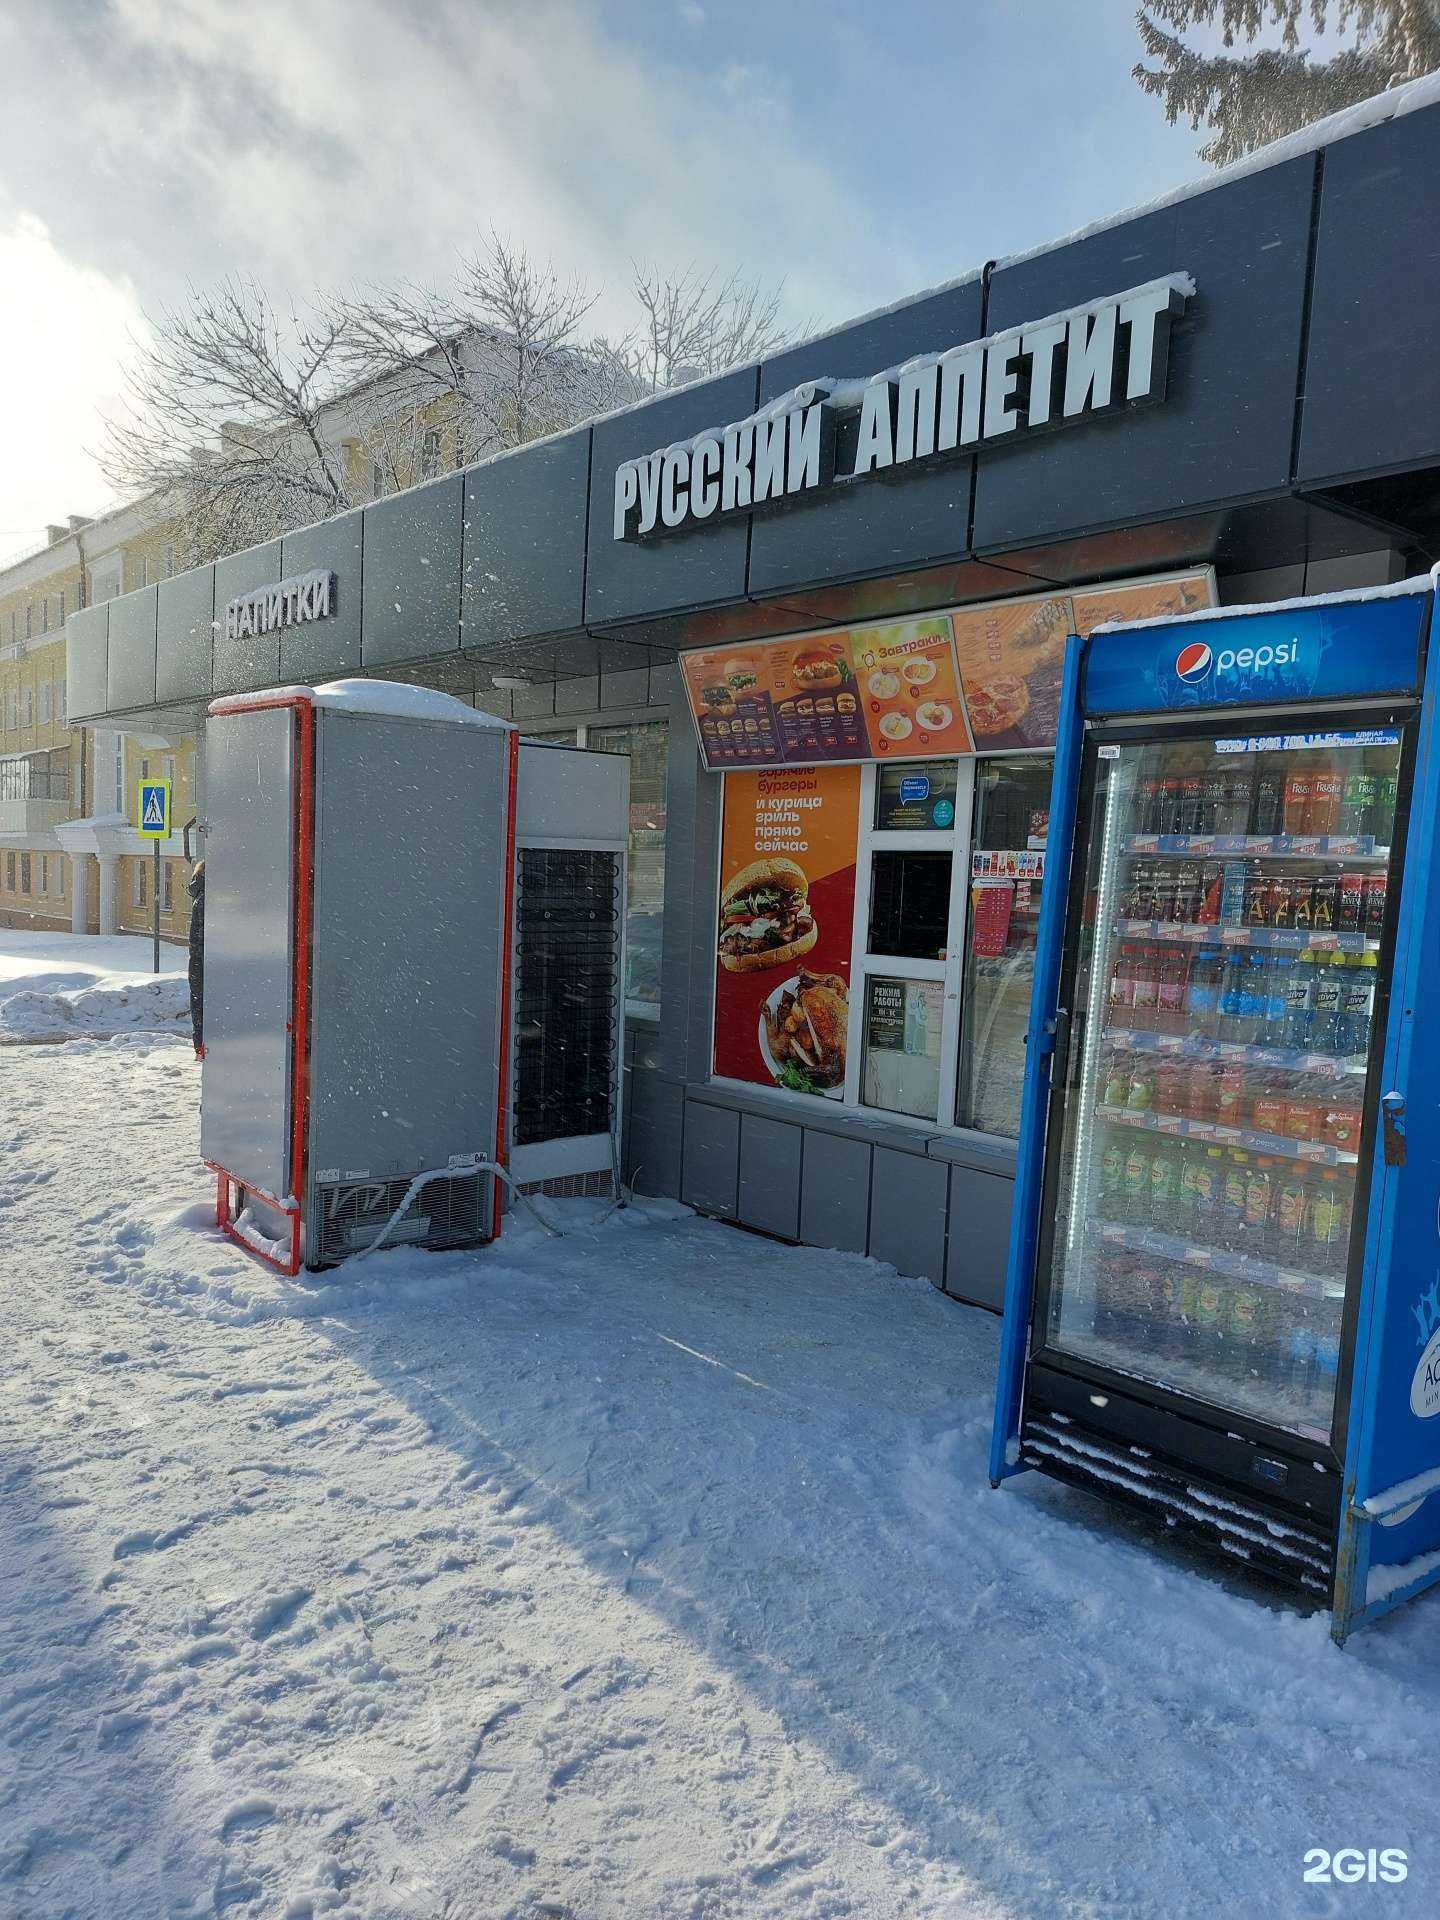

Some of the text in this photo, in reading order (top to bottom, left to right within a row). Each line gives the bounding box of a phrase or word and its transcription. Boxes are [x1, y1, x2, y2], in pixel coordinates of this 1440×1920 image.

[614, 287, 1170, 540] РУССКИЙ АППЕТИТ
[225, 574, 331, 641] НАПИТКИ
[879, 634, 941, 658] Завтраки
[1217, 637, 1298, 676] pepsi
[758, 778, 817, 794] бургеры
[756, 797, 822, 812] и курица
[755, 812, 800, 826] гриль
[754, 825, 802, 840] прямо
[754, 838, 809, 852] сейчас
[874, 986, 901, 998] РЕЖИМ
[873, 996, 902, 1008] РАБОТЫ
